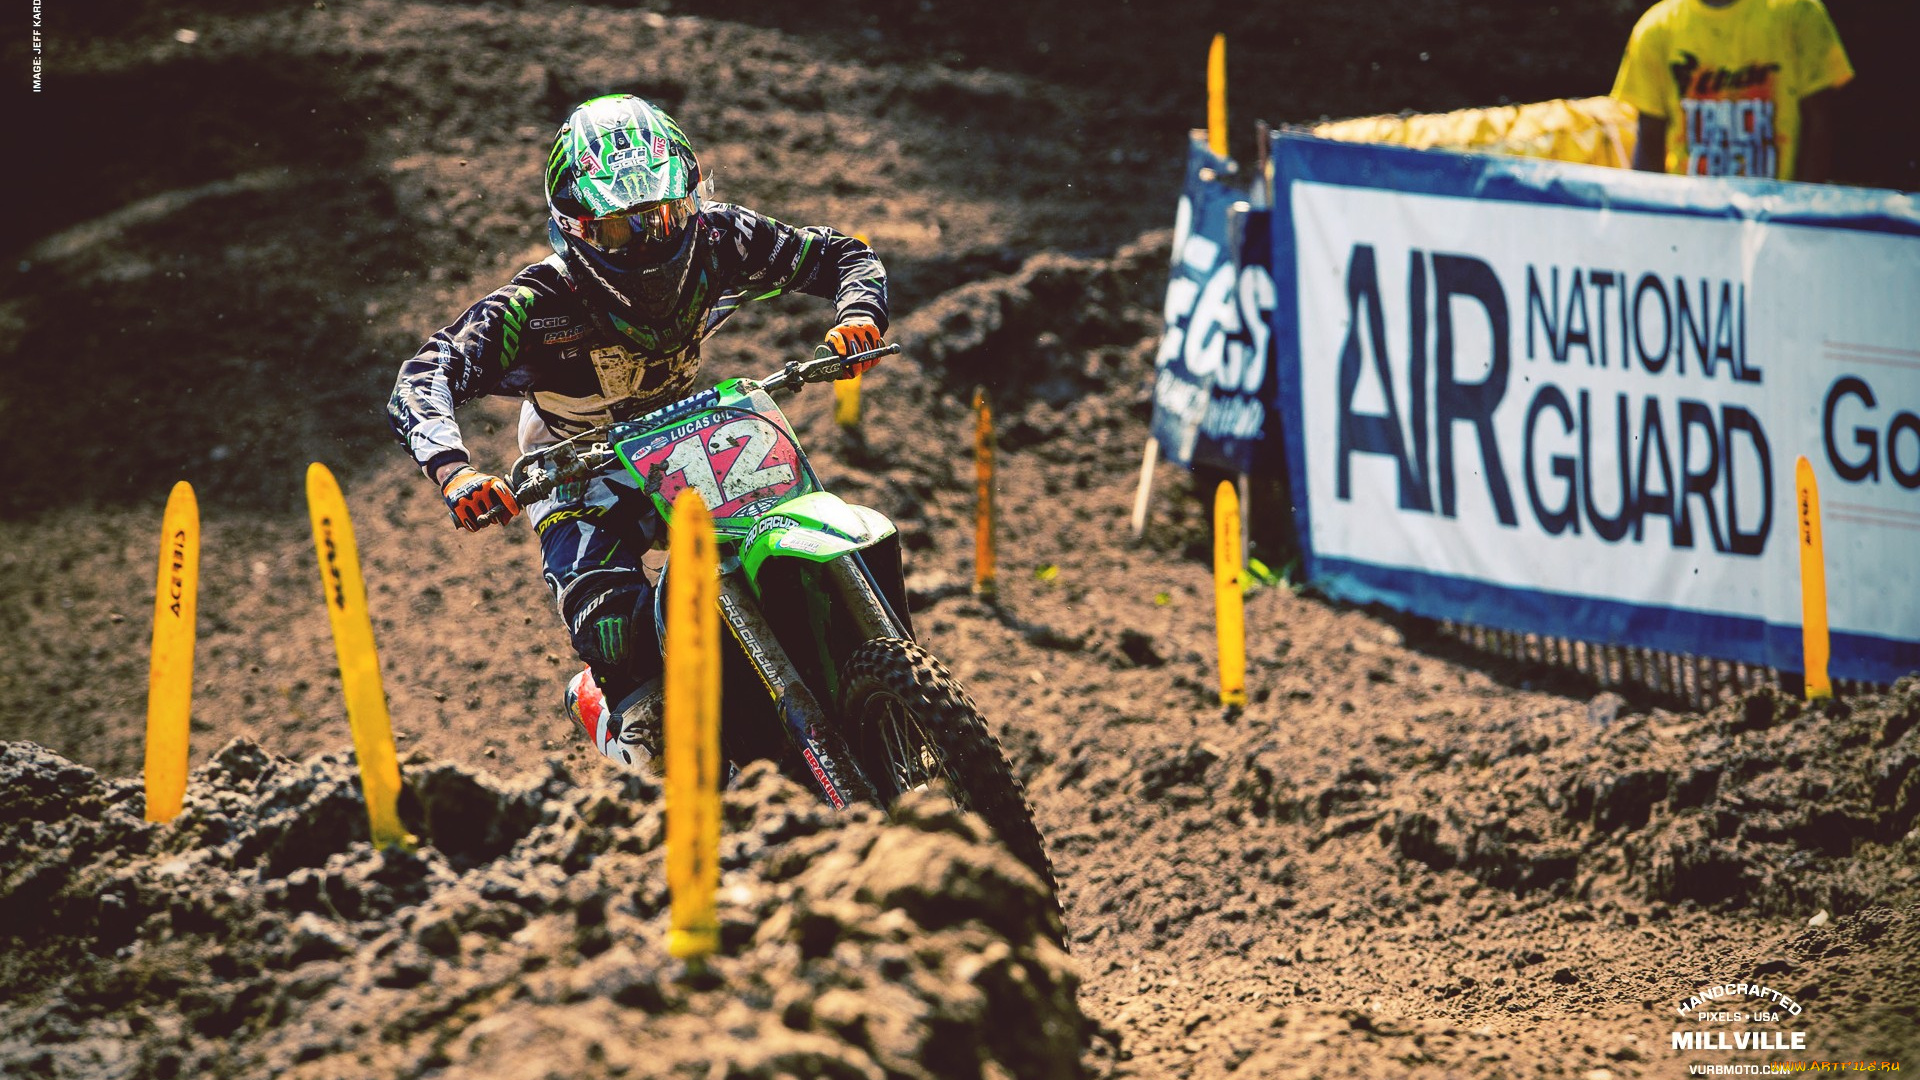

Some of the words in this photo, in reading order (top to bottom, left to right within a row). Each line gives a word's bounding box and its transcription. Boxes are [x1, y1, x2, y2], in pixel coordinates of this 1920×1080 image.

[653, 136, 666, 159] VANS
[1680, 98, 1774, 145] TRACK
[530, 315, 570, 330] OGIO
[1525, 263, 1763, 385] NATIONAL
[1335, 243, 1519, 528] AIR
[670, 418, 710, 441] LUCAS
[712, 410, 733, 423] OIL
[664, 418, 796, 511] 12
[1523, 382, 1774, 556] GUARD
[758, 514, 801, 535] CIRCUIT
[574, 588, 613, 634] thor
[718, 594, 744, 629] PRO
[738, 627, 786, 688] CIRCUIT
[803, 748, 845, 811] BRAKING
